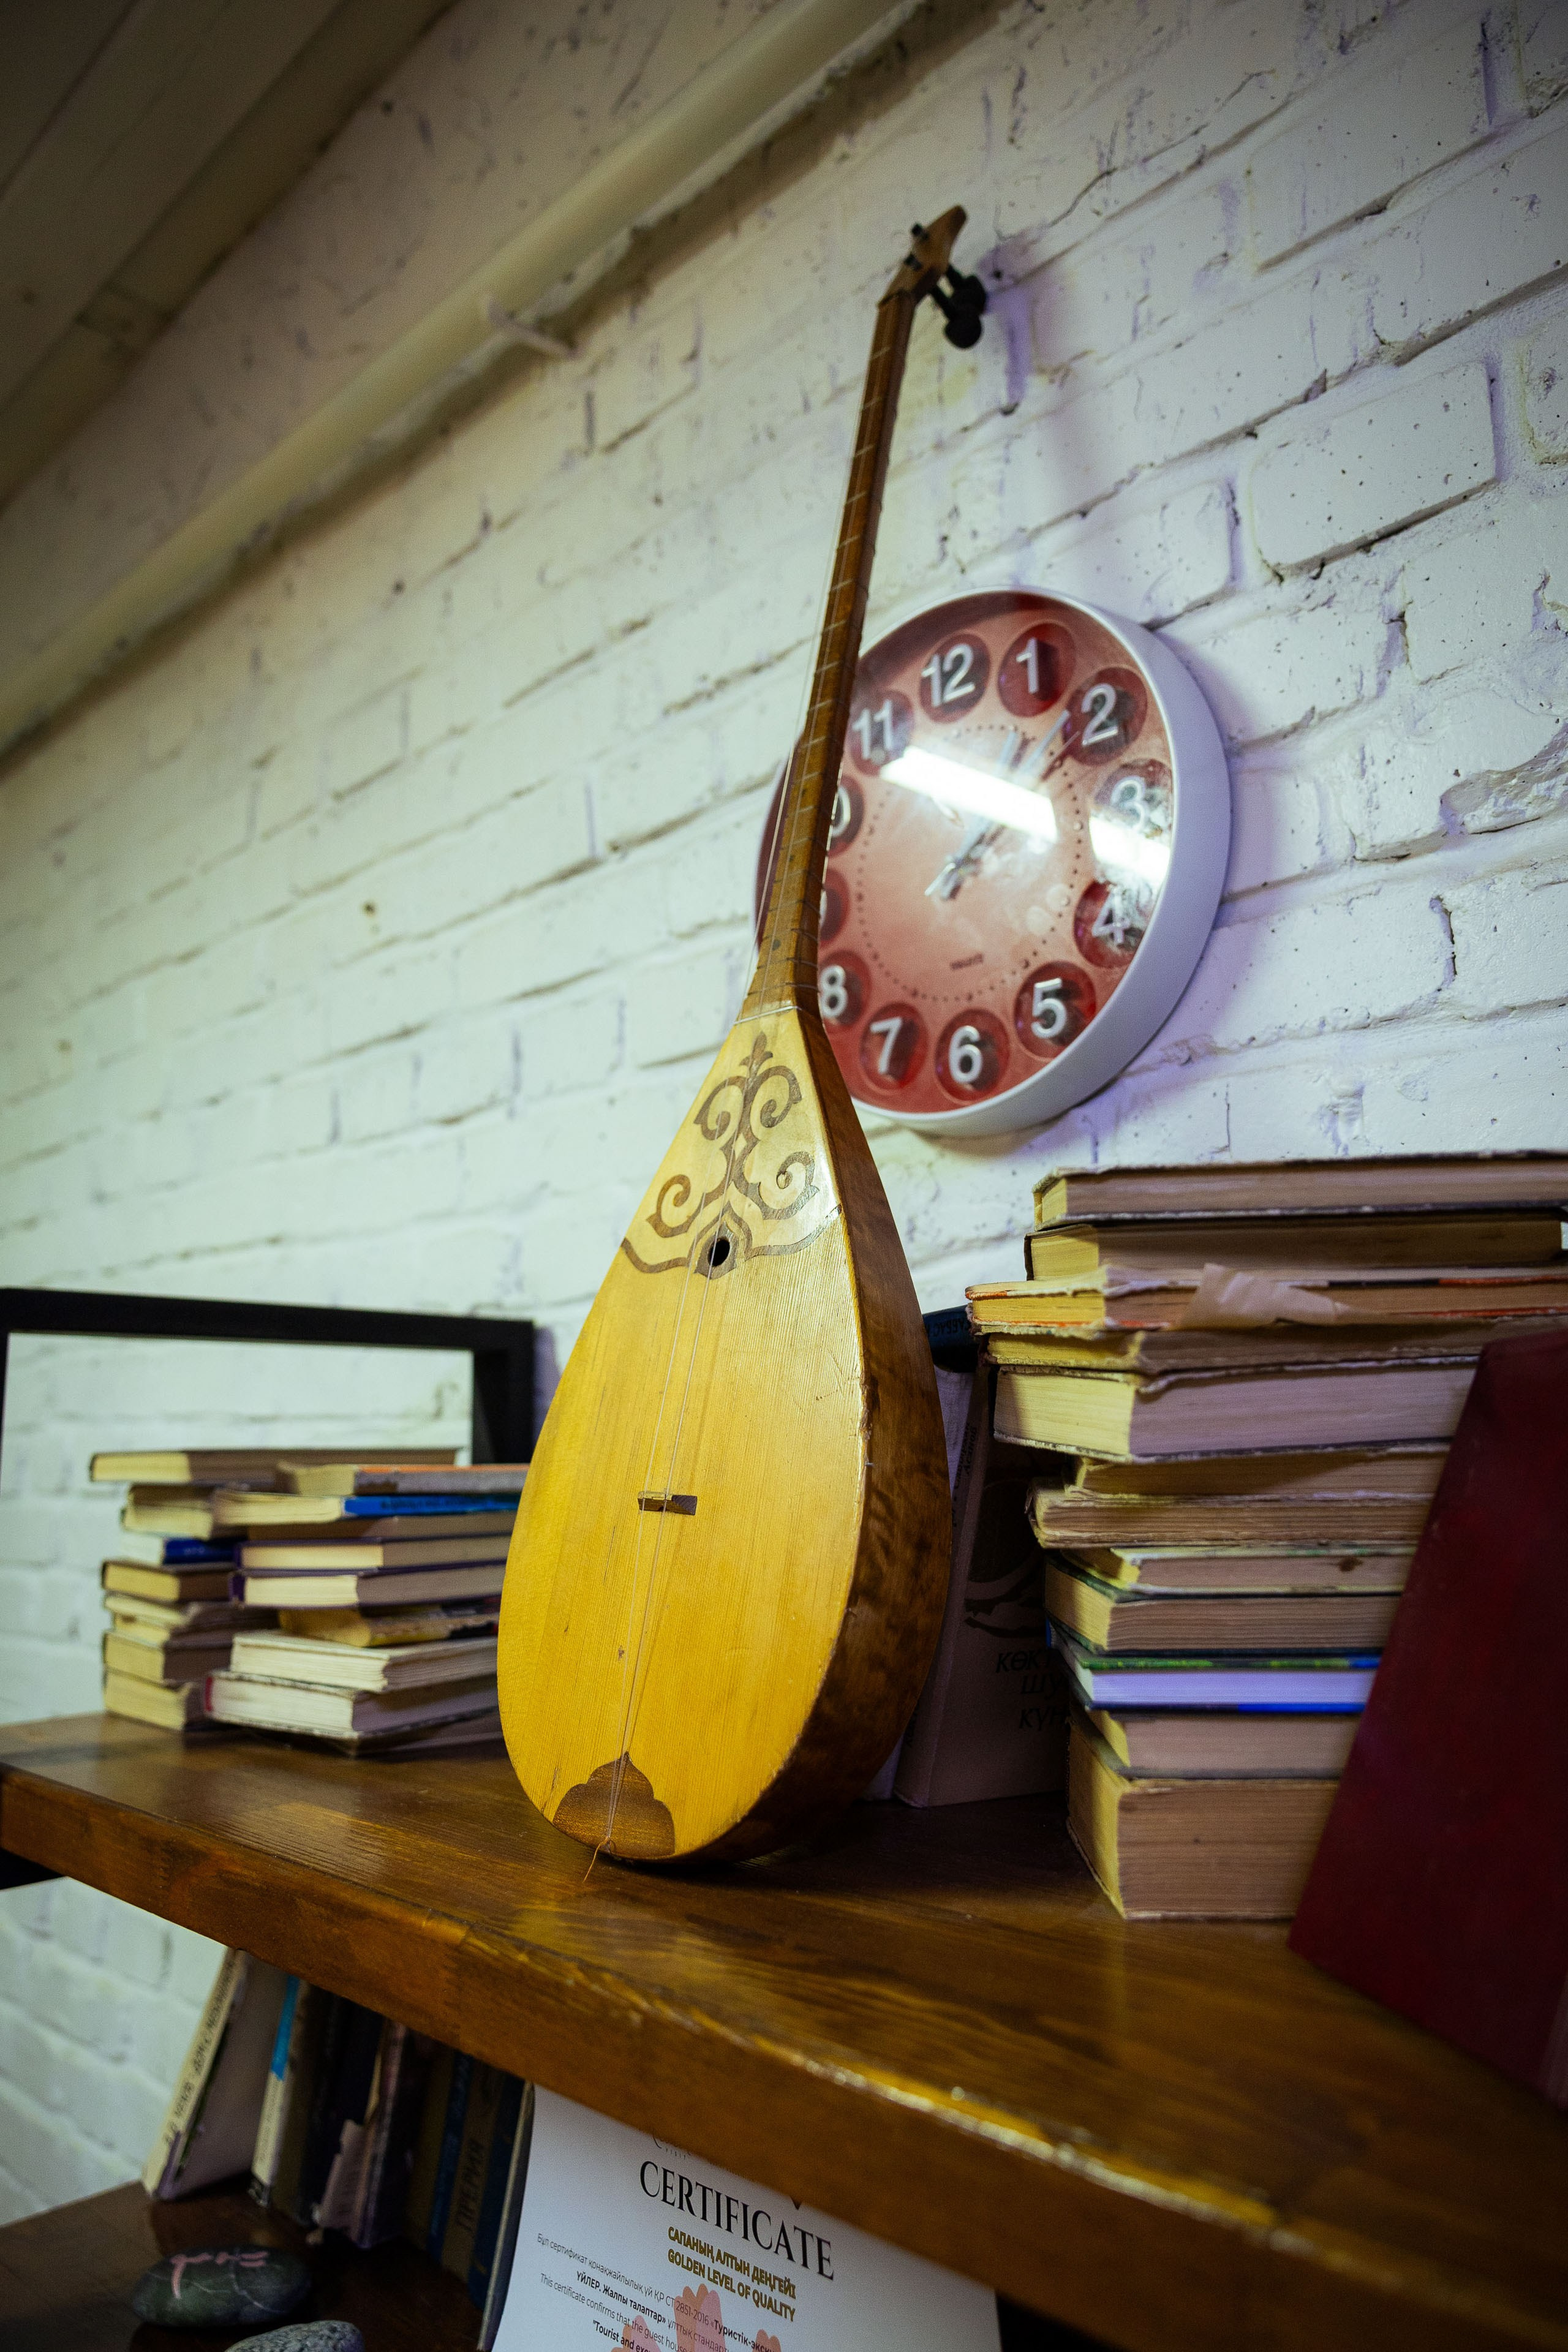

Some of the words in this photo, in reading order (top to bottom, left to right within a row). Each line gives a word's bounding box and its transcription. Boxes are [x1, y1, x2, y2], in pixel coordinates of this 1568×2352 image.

[921, 644, 975, 707] 12
[1016, 637, 1039, 694] 1
[852, 699, 894, 760] 11
[1081, 682, 1118, 747] 2
[1110, 775, 1147, 827] 3
[1092, 885, 1131, 944] 4
[819, 965, 848, 1017] 8
[1031, 978, 1066, 1039] 5
[870, 1017, 903, 1074] 7
[949, 1025, 983, 1085] 6
[640, 2160, 834, 2281] CERTIFICATE
[549, 2241, 588, 2264] сертификат
[676, 2300, 709, 2326] 2851-2016
[668, 2226, 715, 2263] САПАНЫҢ
[715, 2248, 750, 2277] АЛТЫН
[751, 2265, 796, 2300] ДЕҢГЕЙІ
[668, 2248, 706, 2278] GOLDEN
[707, 2266, 736, 2293] LEVEL
[737, 2282, 751, 2299] OF
[752, 2289, 796, 2322] QUALITY
[540, 2272, 553, 2288] This
[554, 2281, 586, 2304] certificate
[586, 2297, 615, 2319] confirms
[616, 2312, 630, 2327] that
[631, 2320, 643, 2334] the
[644, 2328, 665, 2345] guest
[602, 2284, 628, 2305] Жалпы
[620, 2336, 635, 2350] and
